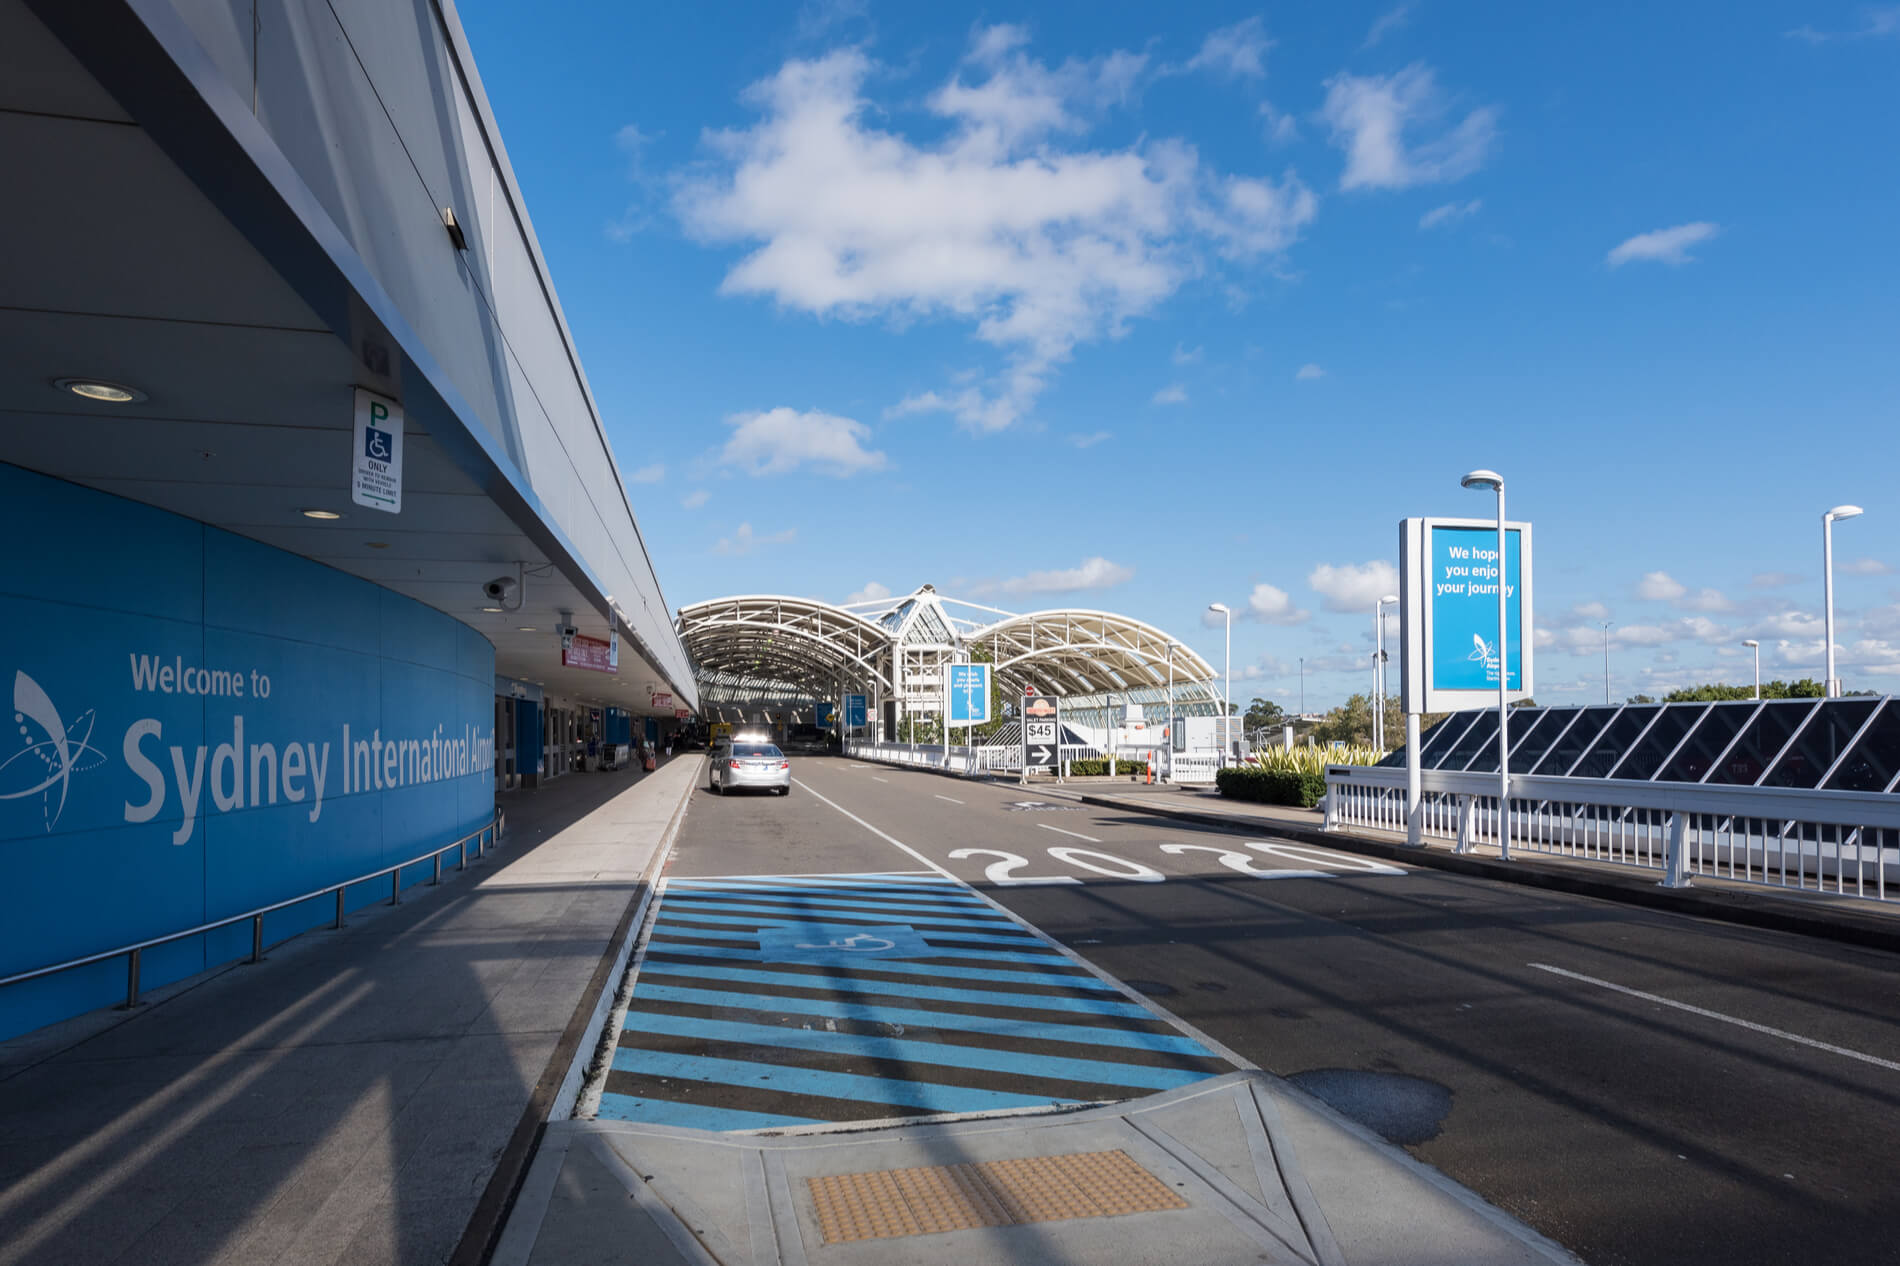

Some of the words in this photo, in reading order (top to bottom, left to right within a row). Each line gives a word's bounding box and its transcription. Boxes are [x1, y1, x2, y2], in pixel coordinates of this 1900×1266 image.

[371, 400, 388, 426] P
[368, 460, 387, 473] ONLY
[1449, 546, 1469, 559] We
[1445, 566, 1468, 579] you
[1472, 565, 1498, 579] enjo
[1436, 583, 1465, 597] your
[130, 653, 244, 697] Welcome
[250, 668, 270, 698] to
[1028, 725, 1051, 737] $45
[123, 716, 329, 846] Sydney
[342, 724, 468, 795] International
